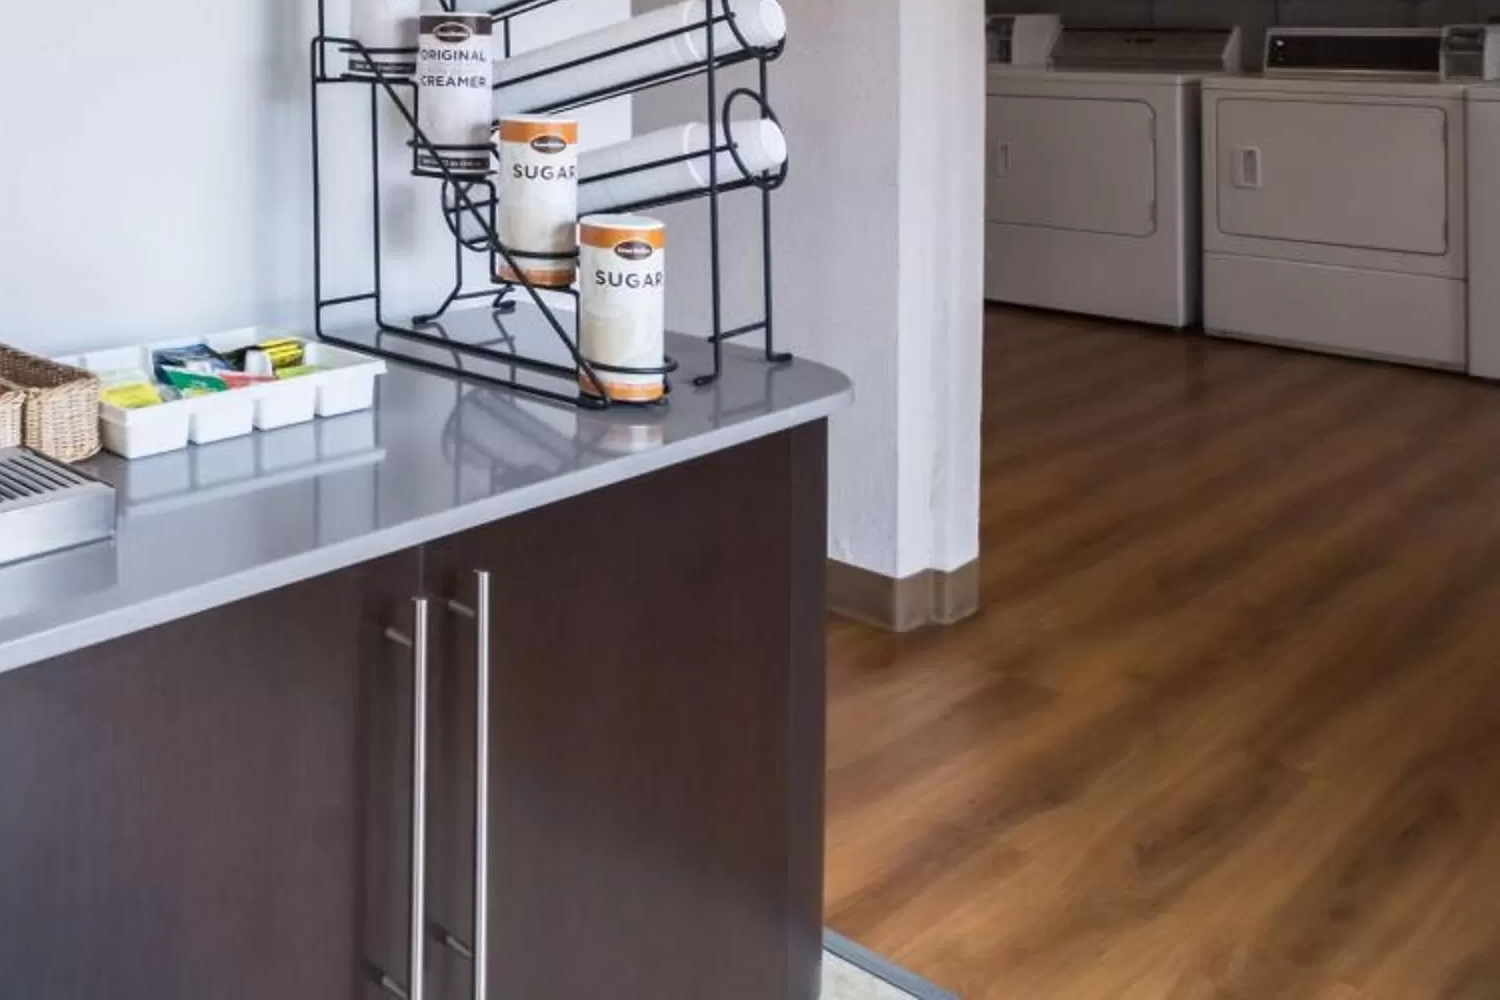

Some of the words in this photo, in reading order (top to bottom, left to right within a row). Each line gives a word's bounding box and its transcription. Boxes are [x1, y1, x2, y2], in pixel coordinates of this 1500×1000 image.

[420, 49, 487, 62] ORIGINAL
[420, 75, 487, 89] CREAMER
[512, 163, 576, 181] SUGAR
[595, 269, 664, 289] SUGAR
